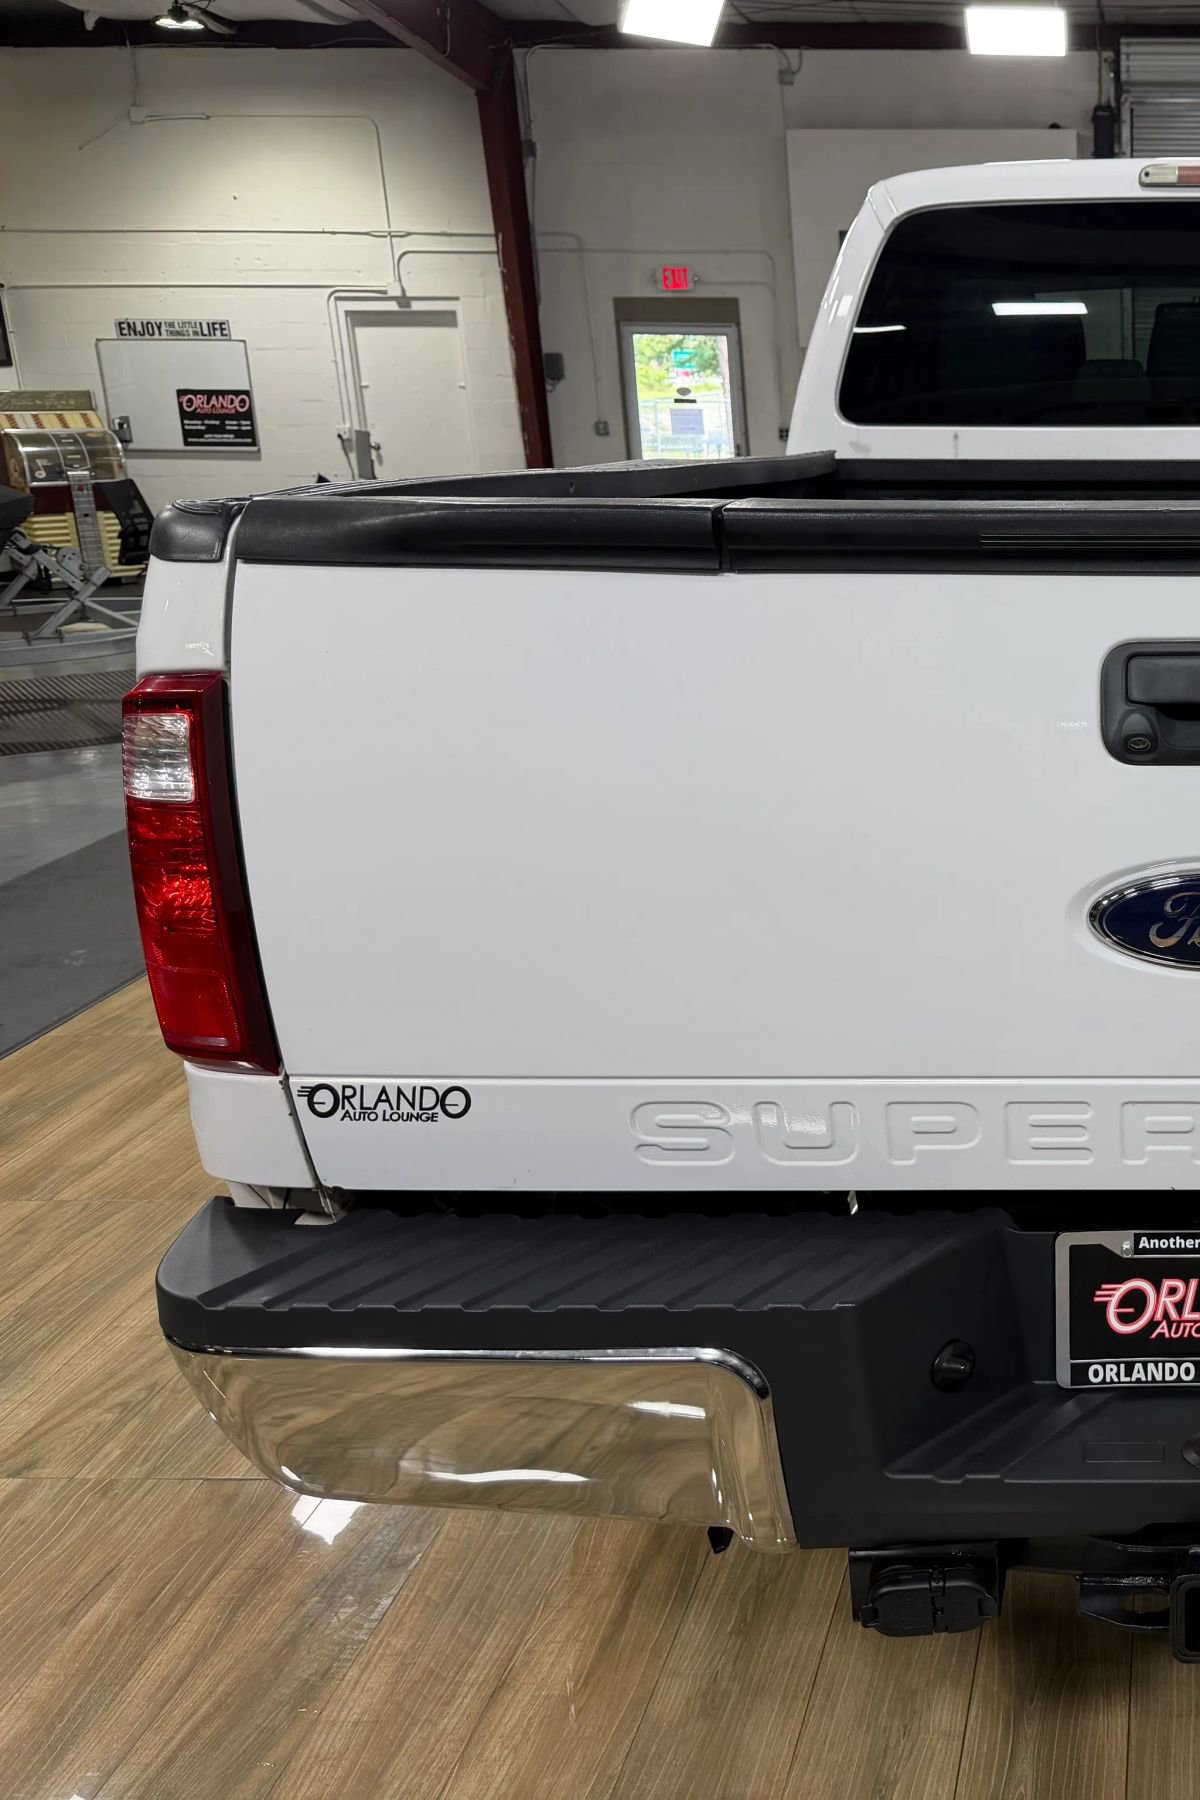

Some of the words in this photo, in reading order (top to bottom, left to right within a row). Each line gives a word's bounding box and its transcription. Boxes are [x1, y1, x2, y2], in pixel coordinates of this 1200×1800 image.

[662, 267, 689, 290] EXIT
[118, 321, 163, 337] ENJOY
[199, 321, 229, 337] LIFE
[182, 395, 249, 412] ORLANDO
[307, 1083, 472, 1119] ORLANDO
[340, 1109, 379, 1122] AUTO
[382, 1110, 439, 1123] LOUNGE
[1138, 1236, 1200, 1249] Another
[1088, 1363, 1196, 1383] ORLANDO
